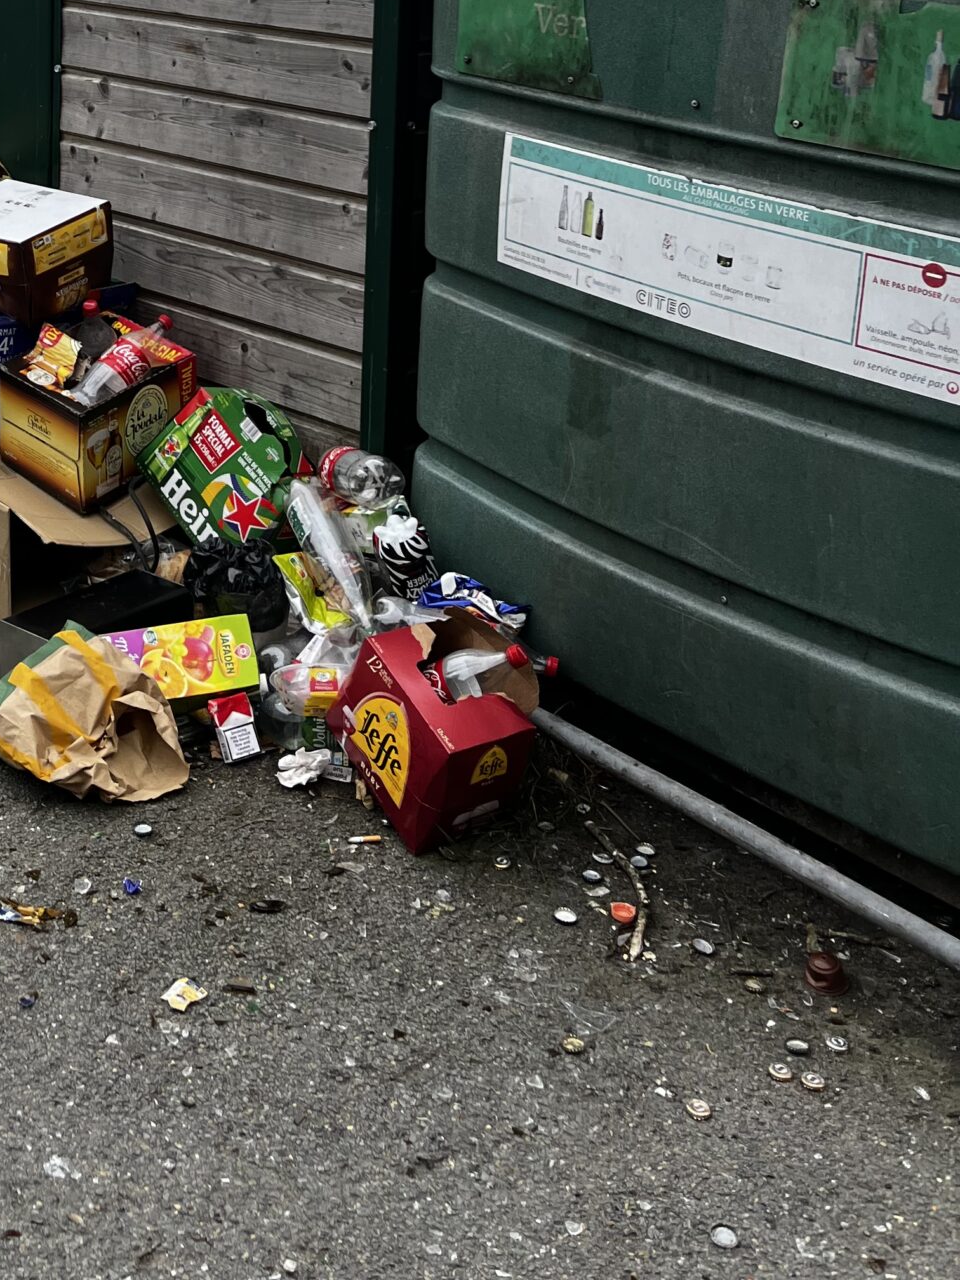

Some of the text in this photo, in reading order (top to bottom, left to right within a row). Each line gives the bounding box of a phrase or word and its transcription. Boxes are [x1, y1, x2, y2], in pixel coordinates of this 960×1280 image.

[647, 173, 809, 222] TOUS LES EMBALLAGES EN VERRE
[636, 289, 691, 318] CITEO
[692, 276, 714, 288] bocaux
[722, 284, 744, 296] flacons
[754, 295, 771, 303] verre
[880, 278, 891, 287] NE
[892, 281, 906, 291] PAS
[907, 284, 942, 300] DÉPOSER
[865, 324, 899, 340] Vaisselle,
[901, 335, 937, 351] ampoule,
[853, 359, 945, 389] un service opéré par
[202, 425, 224, 458] SPECIAL
[208, 415, 235, 450] FORMAT
[406, 572, 429, 588] TIGER
[220, 633, 235, 674] JAFADEN
[366, 655, 383, 673] 12
[358, 709, 402, 778] Leffe
[360, 761, 380, 790] RUBY
[479, 758, 503, 776] Leffe
